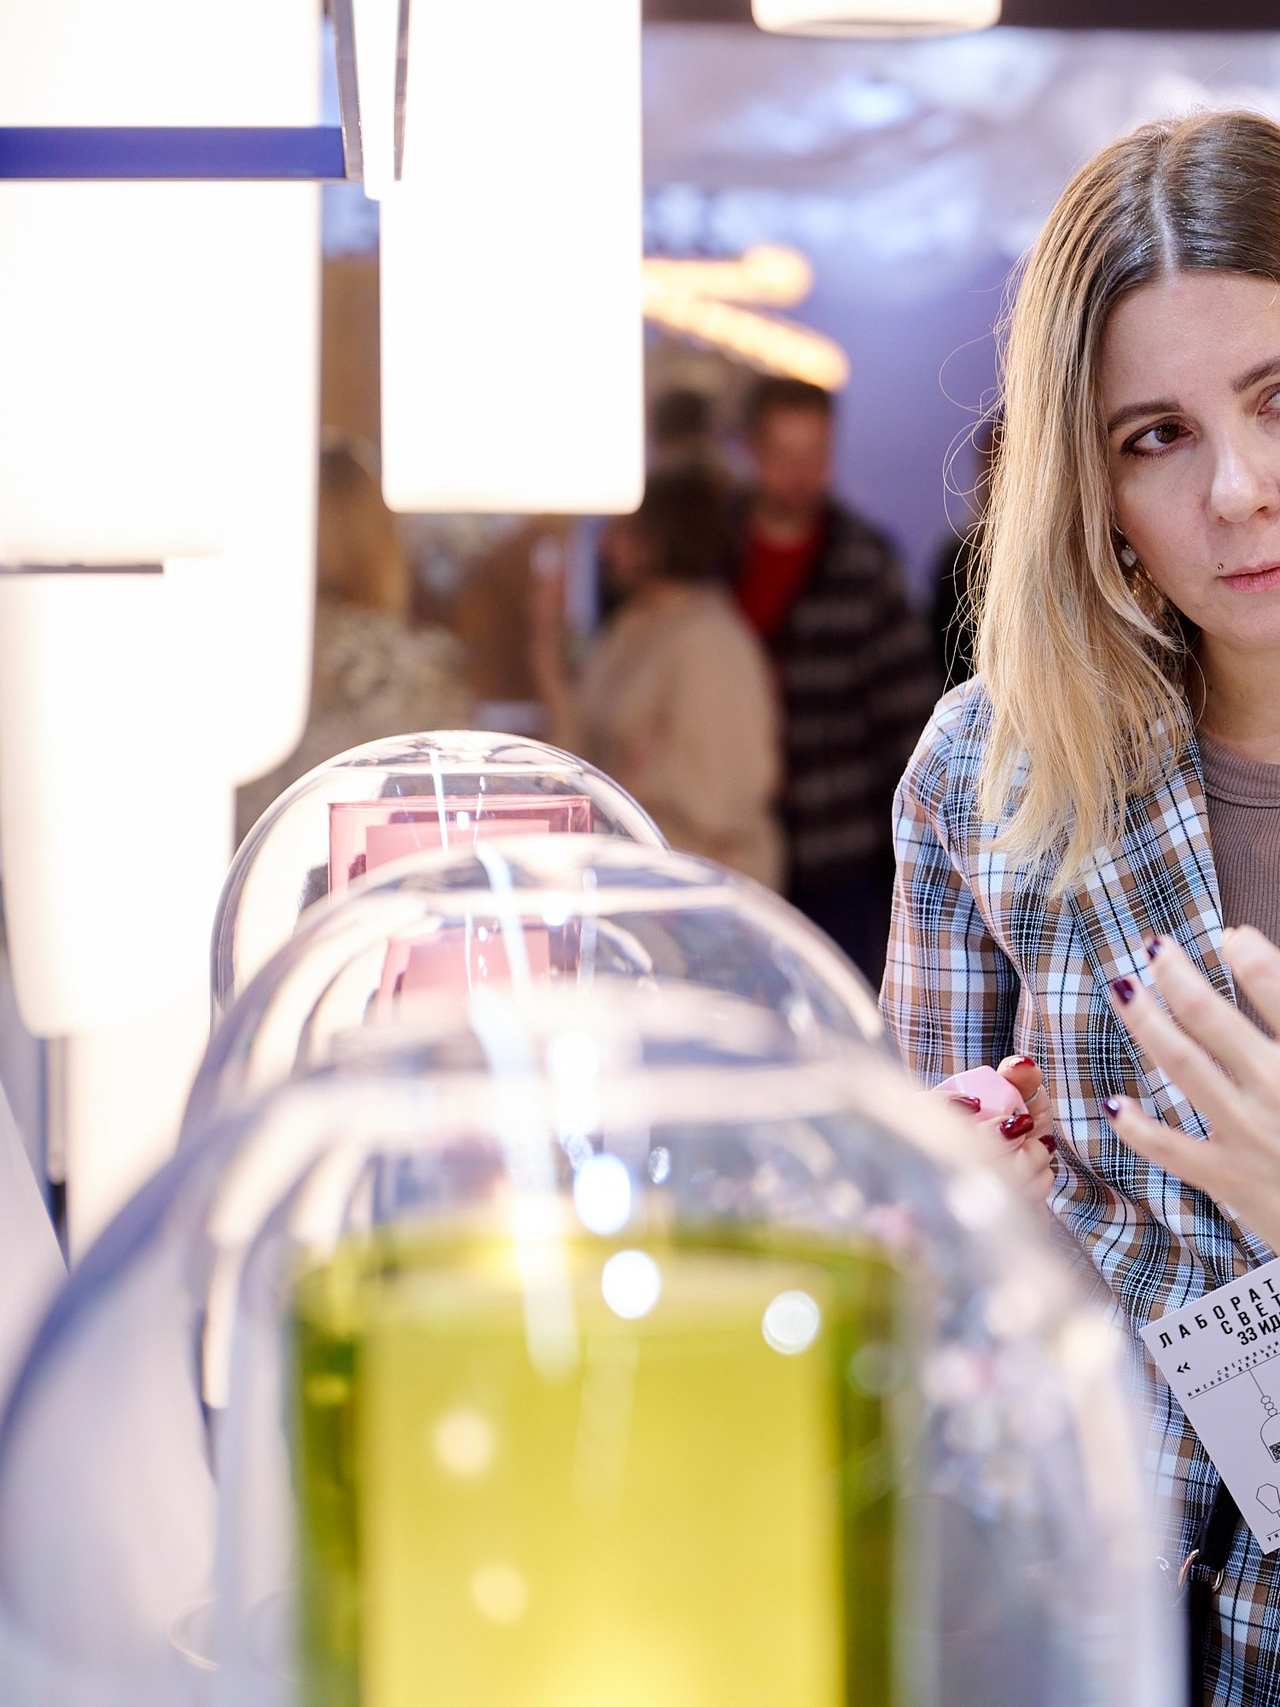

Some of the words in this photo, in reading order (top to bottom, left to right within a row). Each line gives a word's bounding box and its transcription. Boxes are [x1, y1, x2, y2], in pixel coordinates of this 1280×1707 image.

[1237, 1326, 1258, 1346] 33
[1187, 1372, 1230, 1398] ИМЕННО
[1238, 1358, 1258, 1373] ДЛЯ
